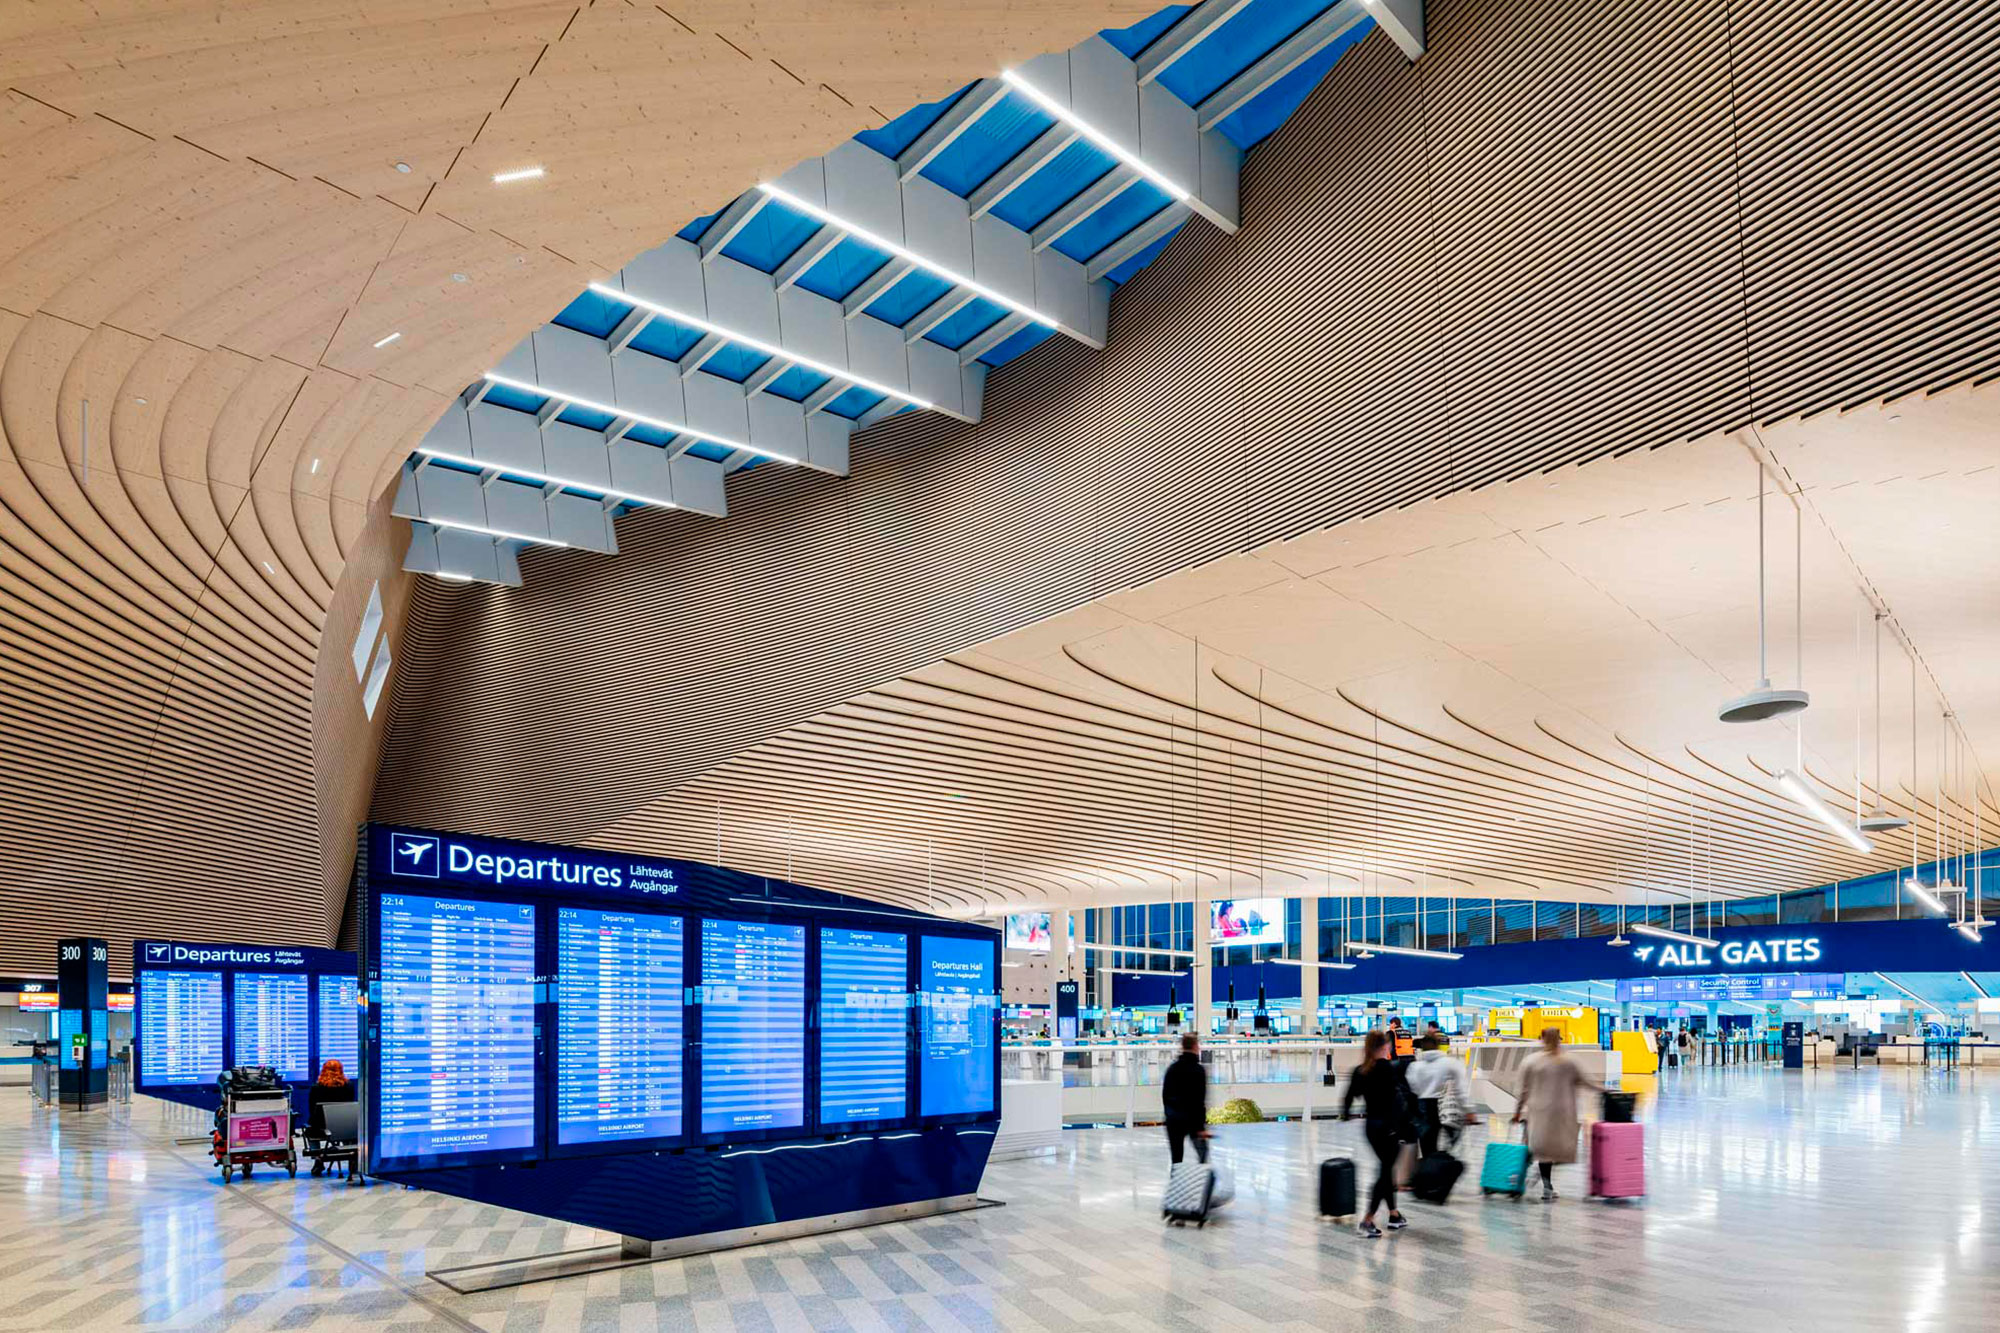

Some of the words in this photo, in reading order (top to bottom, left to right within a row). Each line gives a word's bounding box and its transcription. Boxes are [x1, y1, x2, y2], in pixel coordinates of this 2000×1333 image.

[449, 844, 623, 887] Departures
[630, 865, 673, 879] Lähtevät
[630, 878, 678, 894] Avgångar
[381, 897, 404, 906] 22:14
[435, 901, 475, 912] Departures
[559, 911, 577, 919] 22:14
[602, 914, 635, 923] Departures
[738, 924, 765, 932] Departures
[62, 946, 81, 960] 300
[92, 947, 107, 962] 300
[175, 947, 271, 964] Departures
[1659, 944, 1711, 967] ALL
[1721, 938, 1820, 964] GATES
[932, 961, 969, 970] Departures
[970, 962, 983, 971] Hall
[24, 984, 42, 992] 307
[1700, 979, 1730, 987] Security
[1060, 984, 1075, 993] 400
